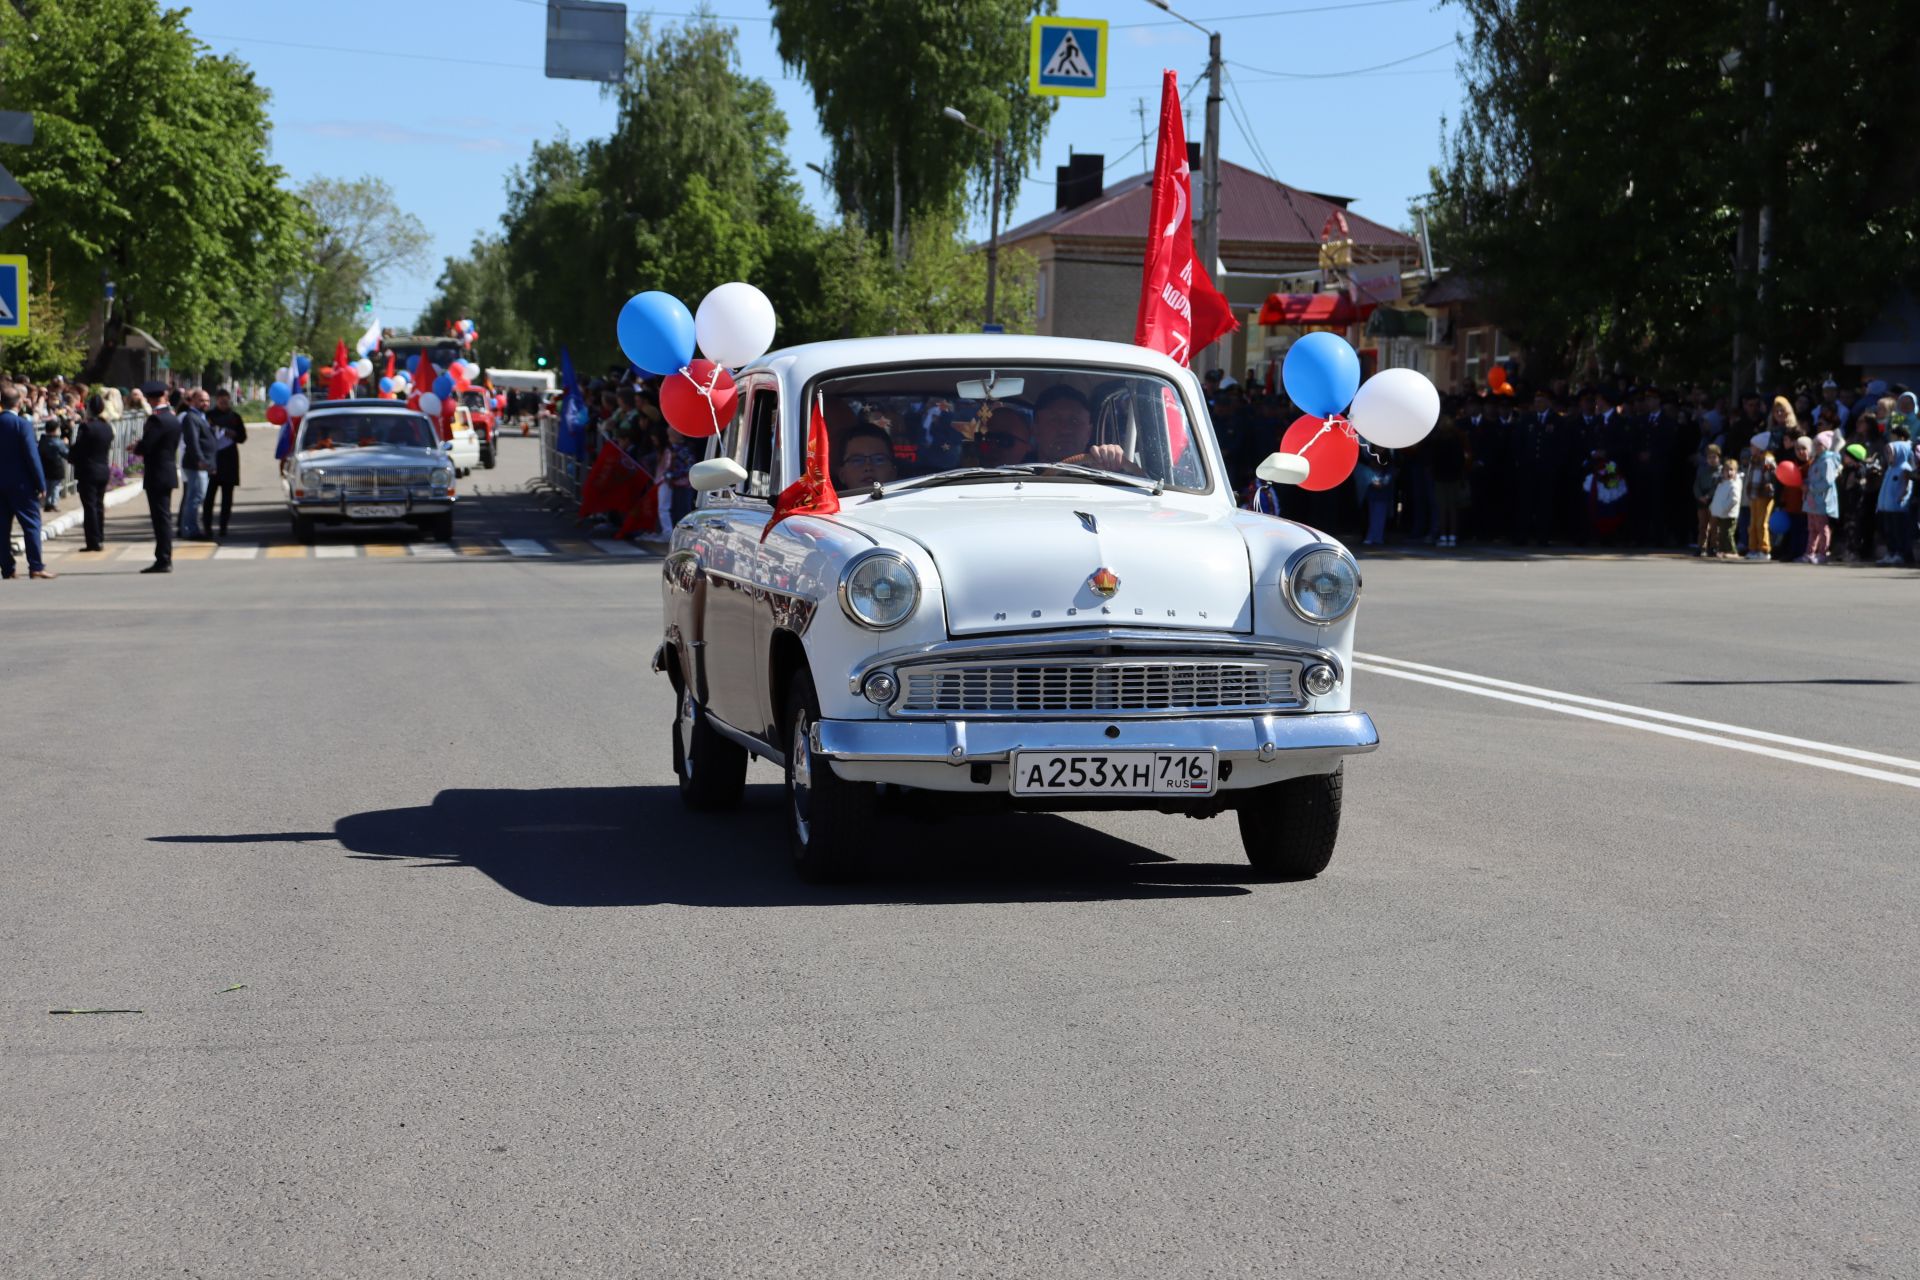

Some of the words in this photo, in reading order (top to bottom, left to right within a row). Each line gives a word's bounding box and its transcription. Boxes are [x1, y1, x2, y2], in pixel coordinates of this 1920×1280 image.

[1026, 757, 1150, 788] А253ХН
[1158, 756, 1204, 779] 716
[1167, 780, 1190, 788] RUS
